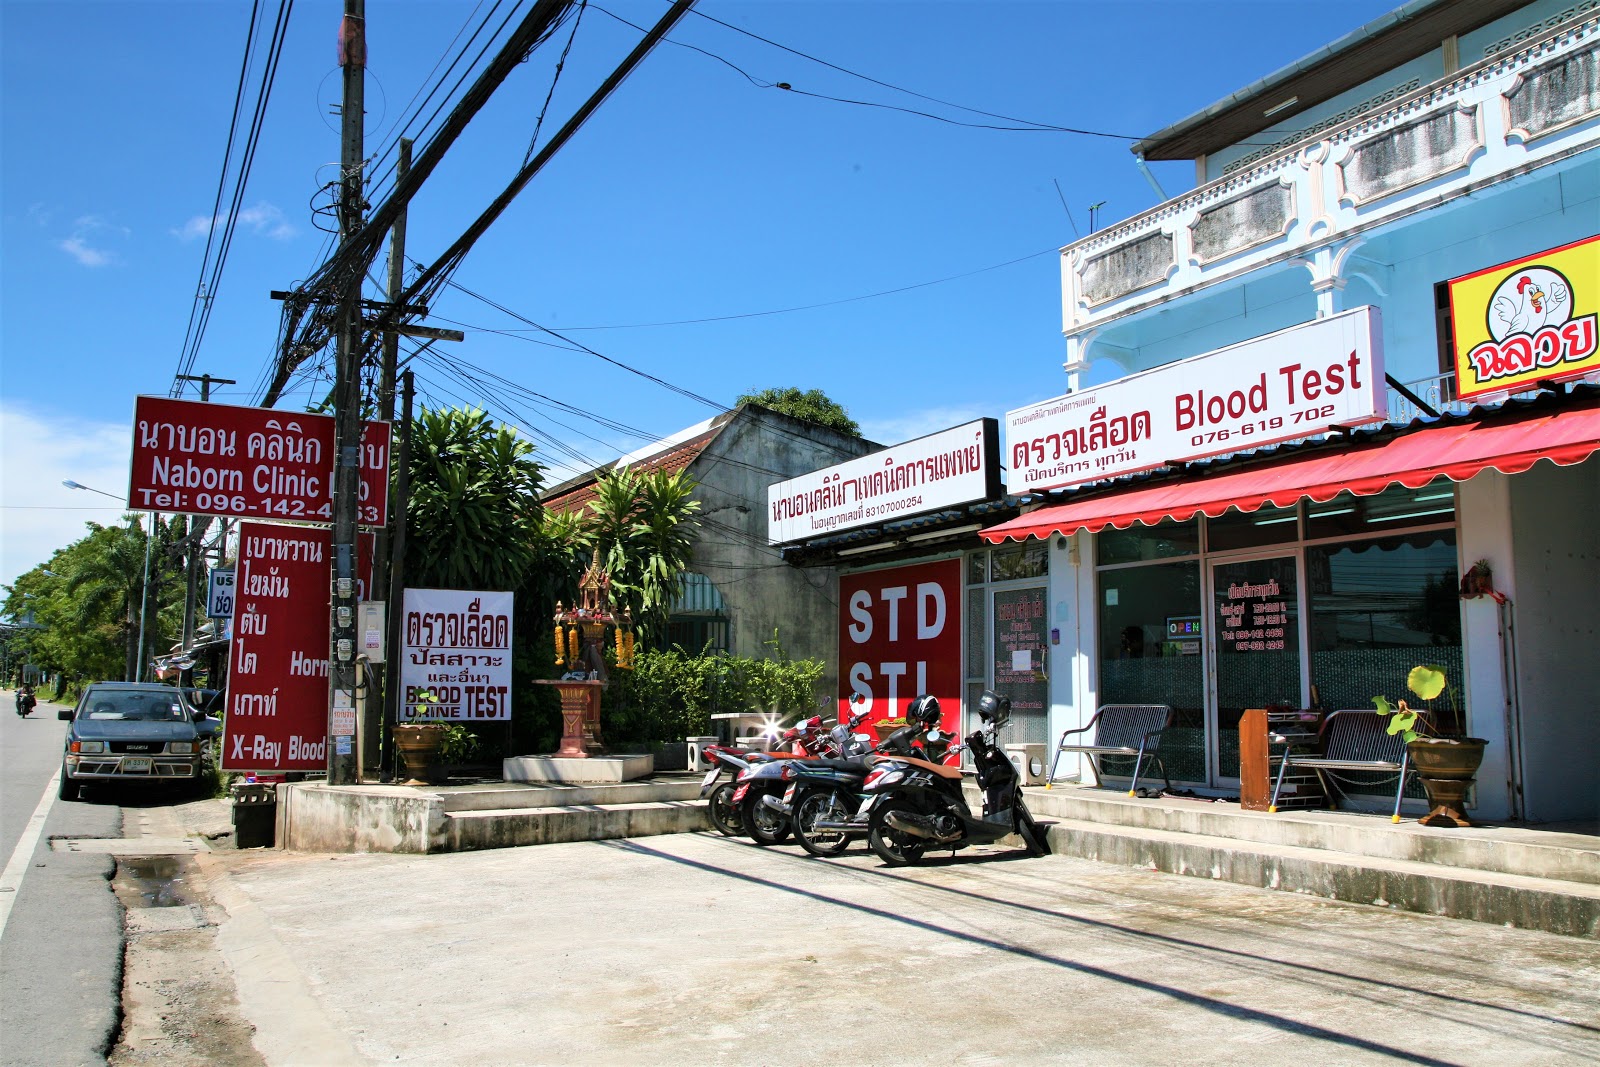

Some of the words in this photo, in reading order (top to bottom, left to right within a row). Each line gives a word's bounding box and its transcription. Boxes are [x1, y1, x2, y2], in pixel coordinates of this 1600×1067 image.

[1175, 372, 1268, 432] Blood
[1279, 348, 1362, 406] Test
[139, 420, 237, 457] นาบอน
[247, 419, 322, 465] คลินิก
[1013, 405, 1152, 470] ตรวจเลือด
[1191, 416, 1283, 447] 076-619
[1290, 404, 1336, 425] 702
[151, 456, 244, 492] Naborn
[252, 464, 320, 498] Clinic
[1025, 458, 1090, 483] เปิดบริการ
[1095, 447, 1137, 471] ทุกวัน
[138, 488, 188, 507] Tel:
[196, 493, 379, 522] 096-142-43
[866, 495, 923, 518] 83107000254
[246, 535, 323, 563] เบาหวาน
[242, 560, 290, 598] ไขมัน
[240, 603, 268, 636] ตับ
[407, 597, 509, 648] ตรวจเลือด
[848, 581, 947, 644] STD
[1170, 622, 1199, 633] OPEN
[237, 638, 258, 675] ไต
[410, 648, 503, 667] ปัสสาวะ
[234, 687, 279, 716] เกาท์
[464, 686, 508, 718] TEST
[231, 734, 282, 767] X-Ray
[288, 735, 326, 760] Blood
